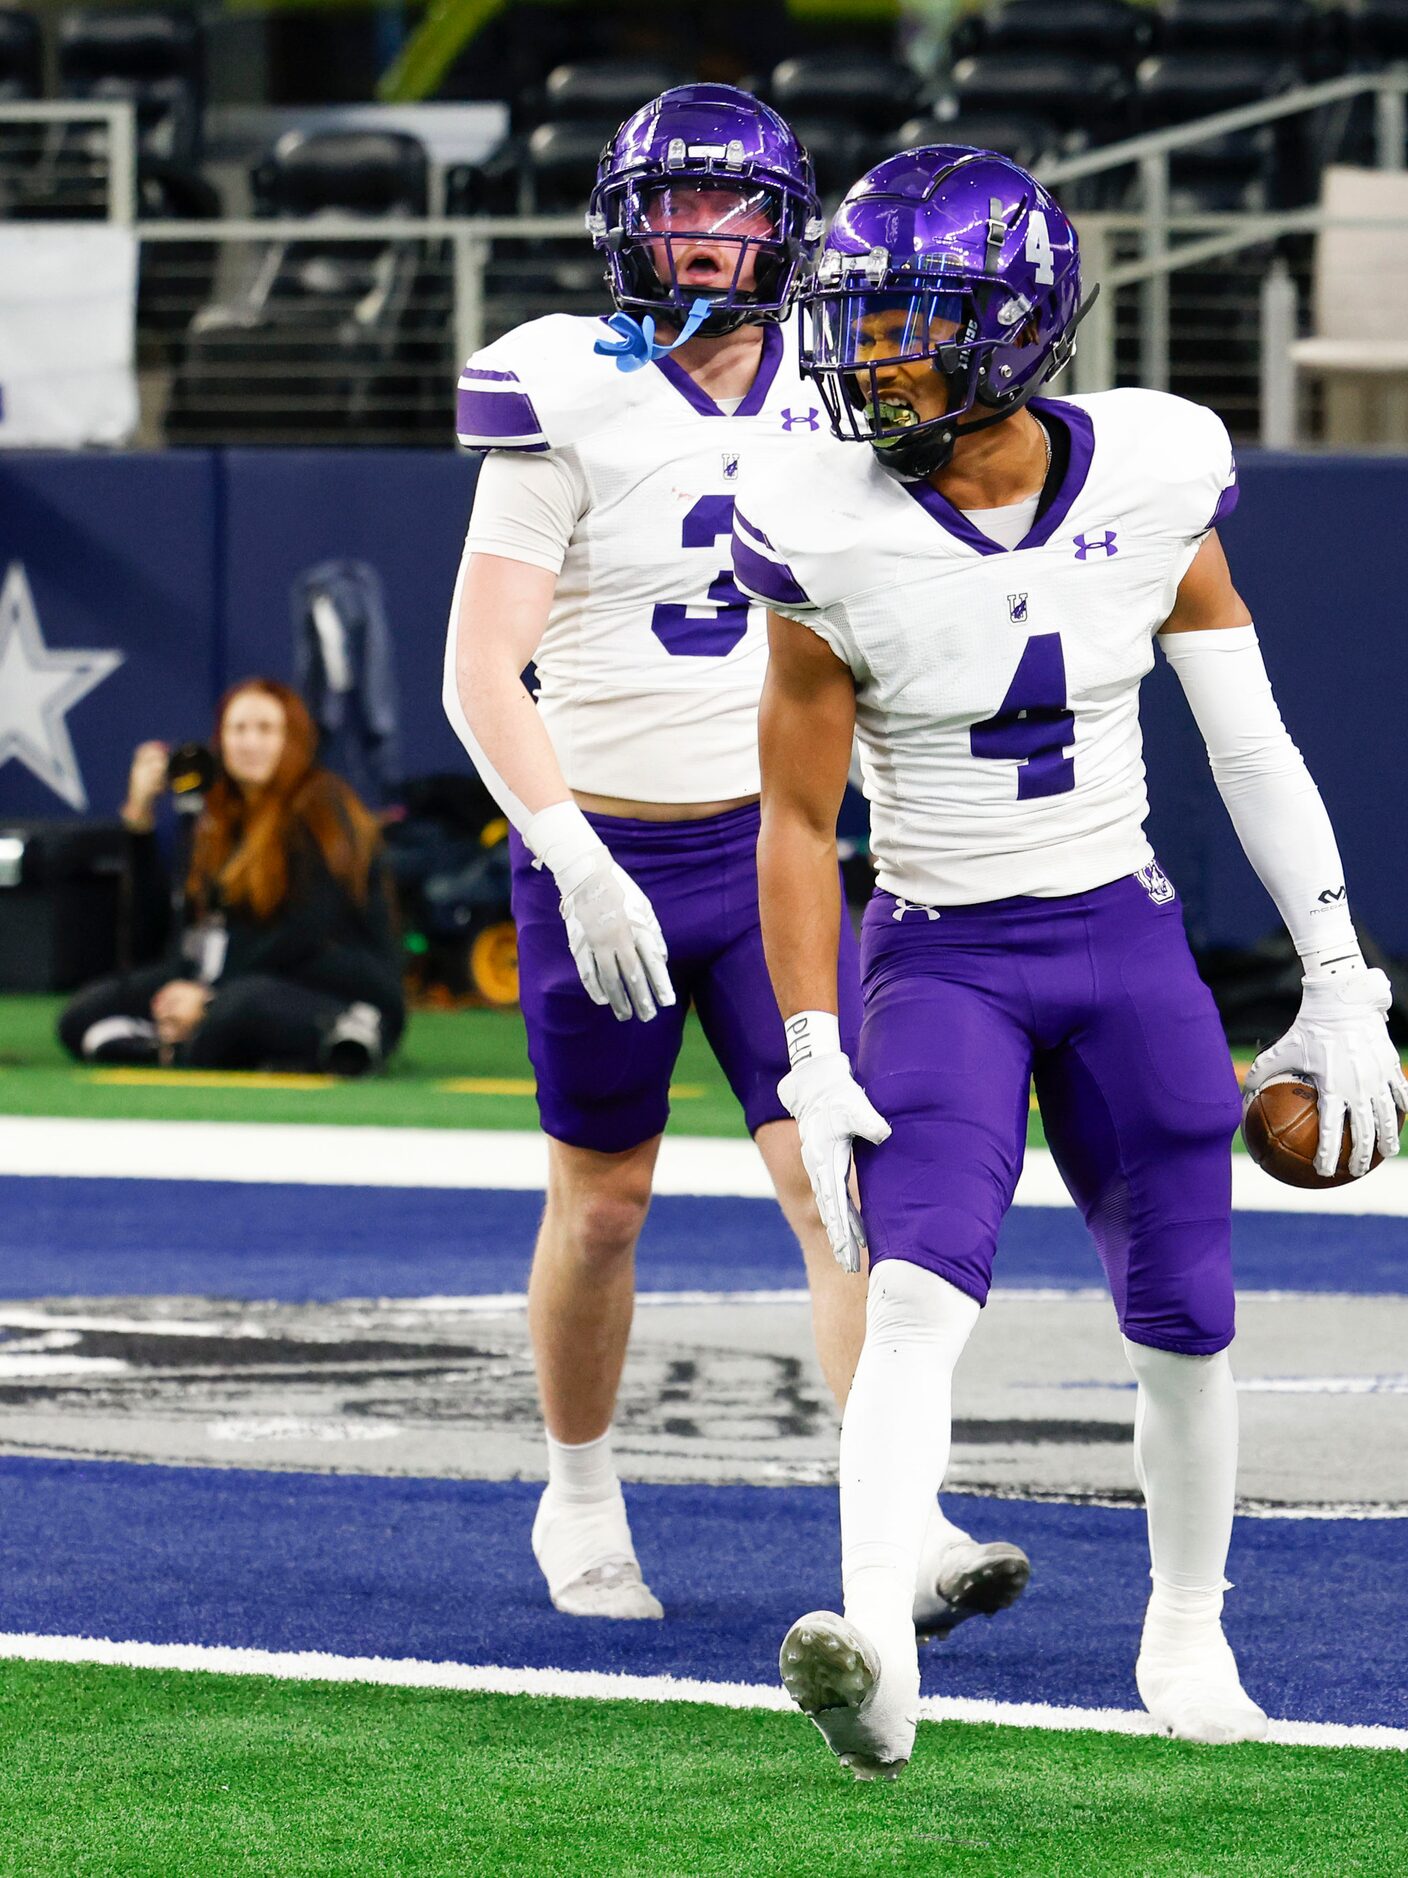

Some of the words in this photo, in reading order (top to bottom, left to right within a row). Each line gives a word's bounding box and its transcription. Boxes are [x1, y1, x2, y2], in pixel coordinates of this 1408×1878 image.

[1025, 209, 1055, 286] 4
[651, 494, 750, 657] 3
[970, 631, 1076, 801] 4
